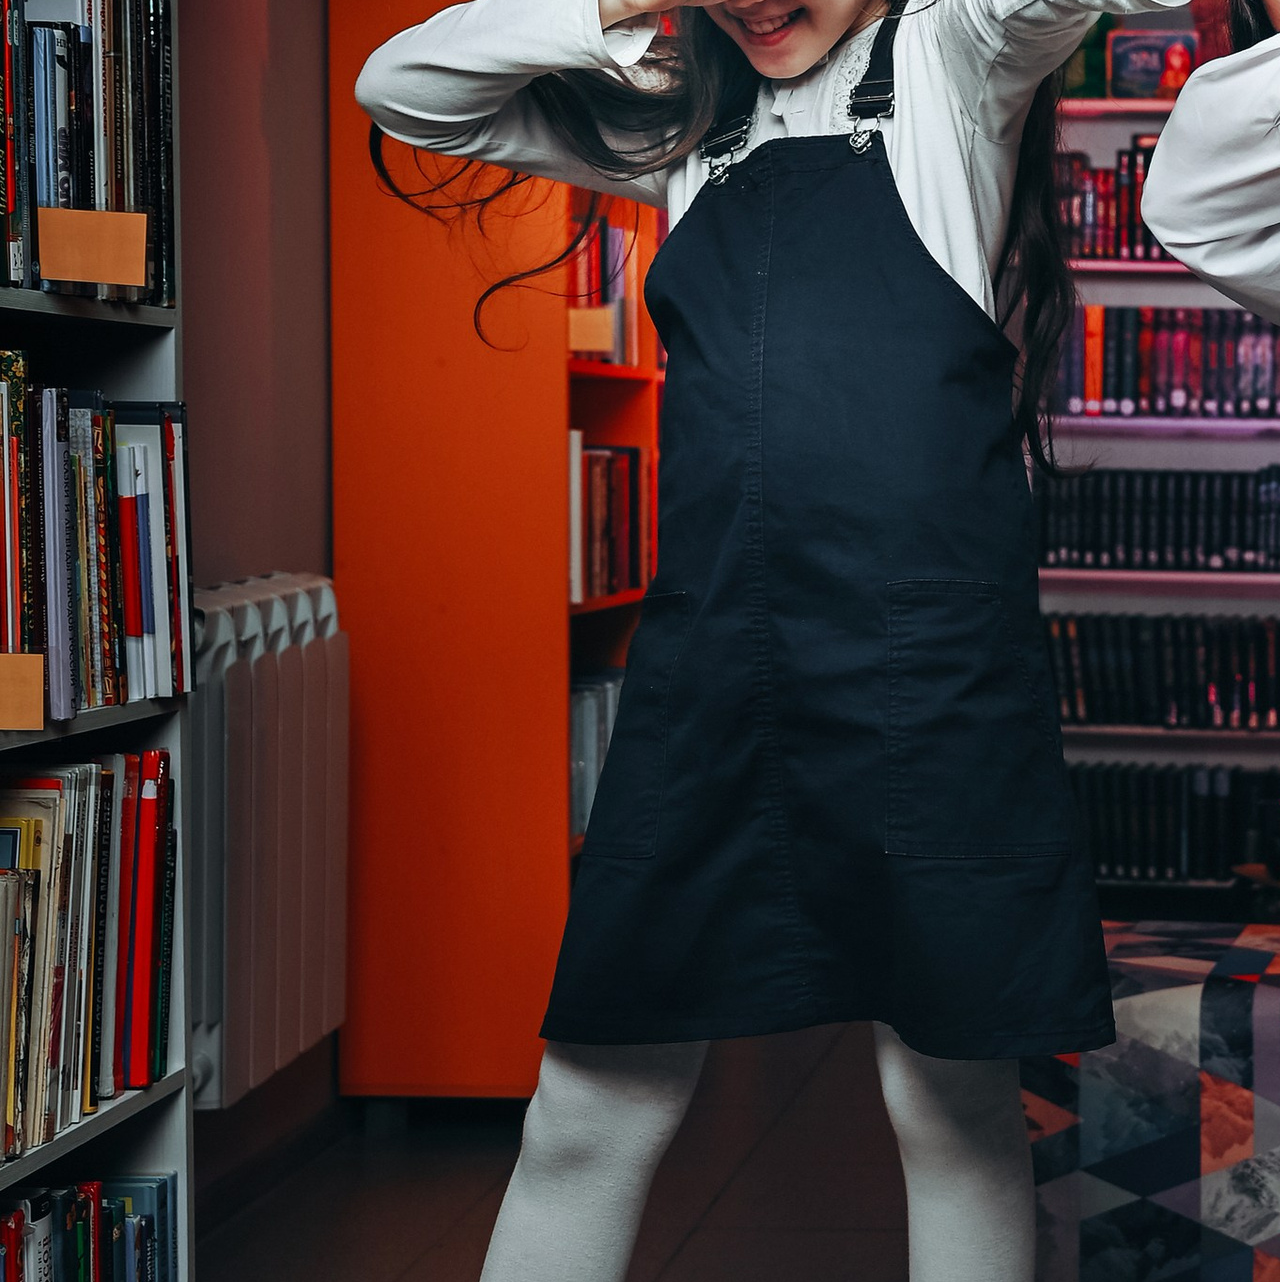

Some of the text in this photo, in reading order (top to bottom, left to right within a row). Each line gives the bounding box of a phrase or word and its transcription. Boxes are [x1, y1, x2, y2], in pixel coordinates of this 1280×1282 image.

[58, 126, 71, 173] МИР
[64, 502, 70, 514] И
[66, 576, 74, 632] НАРОДОВ
[68, 633, 76, 688] РОССИИ
[97, 850, 108, 941] НА САМОМ
